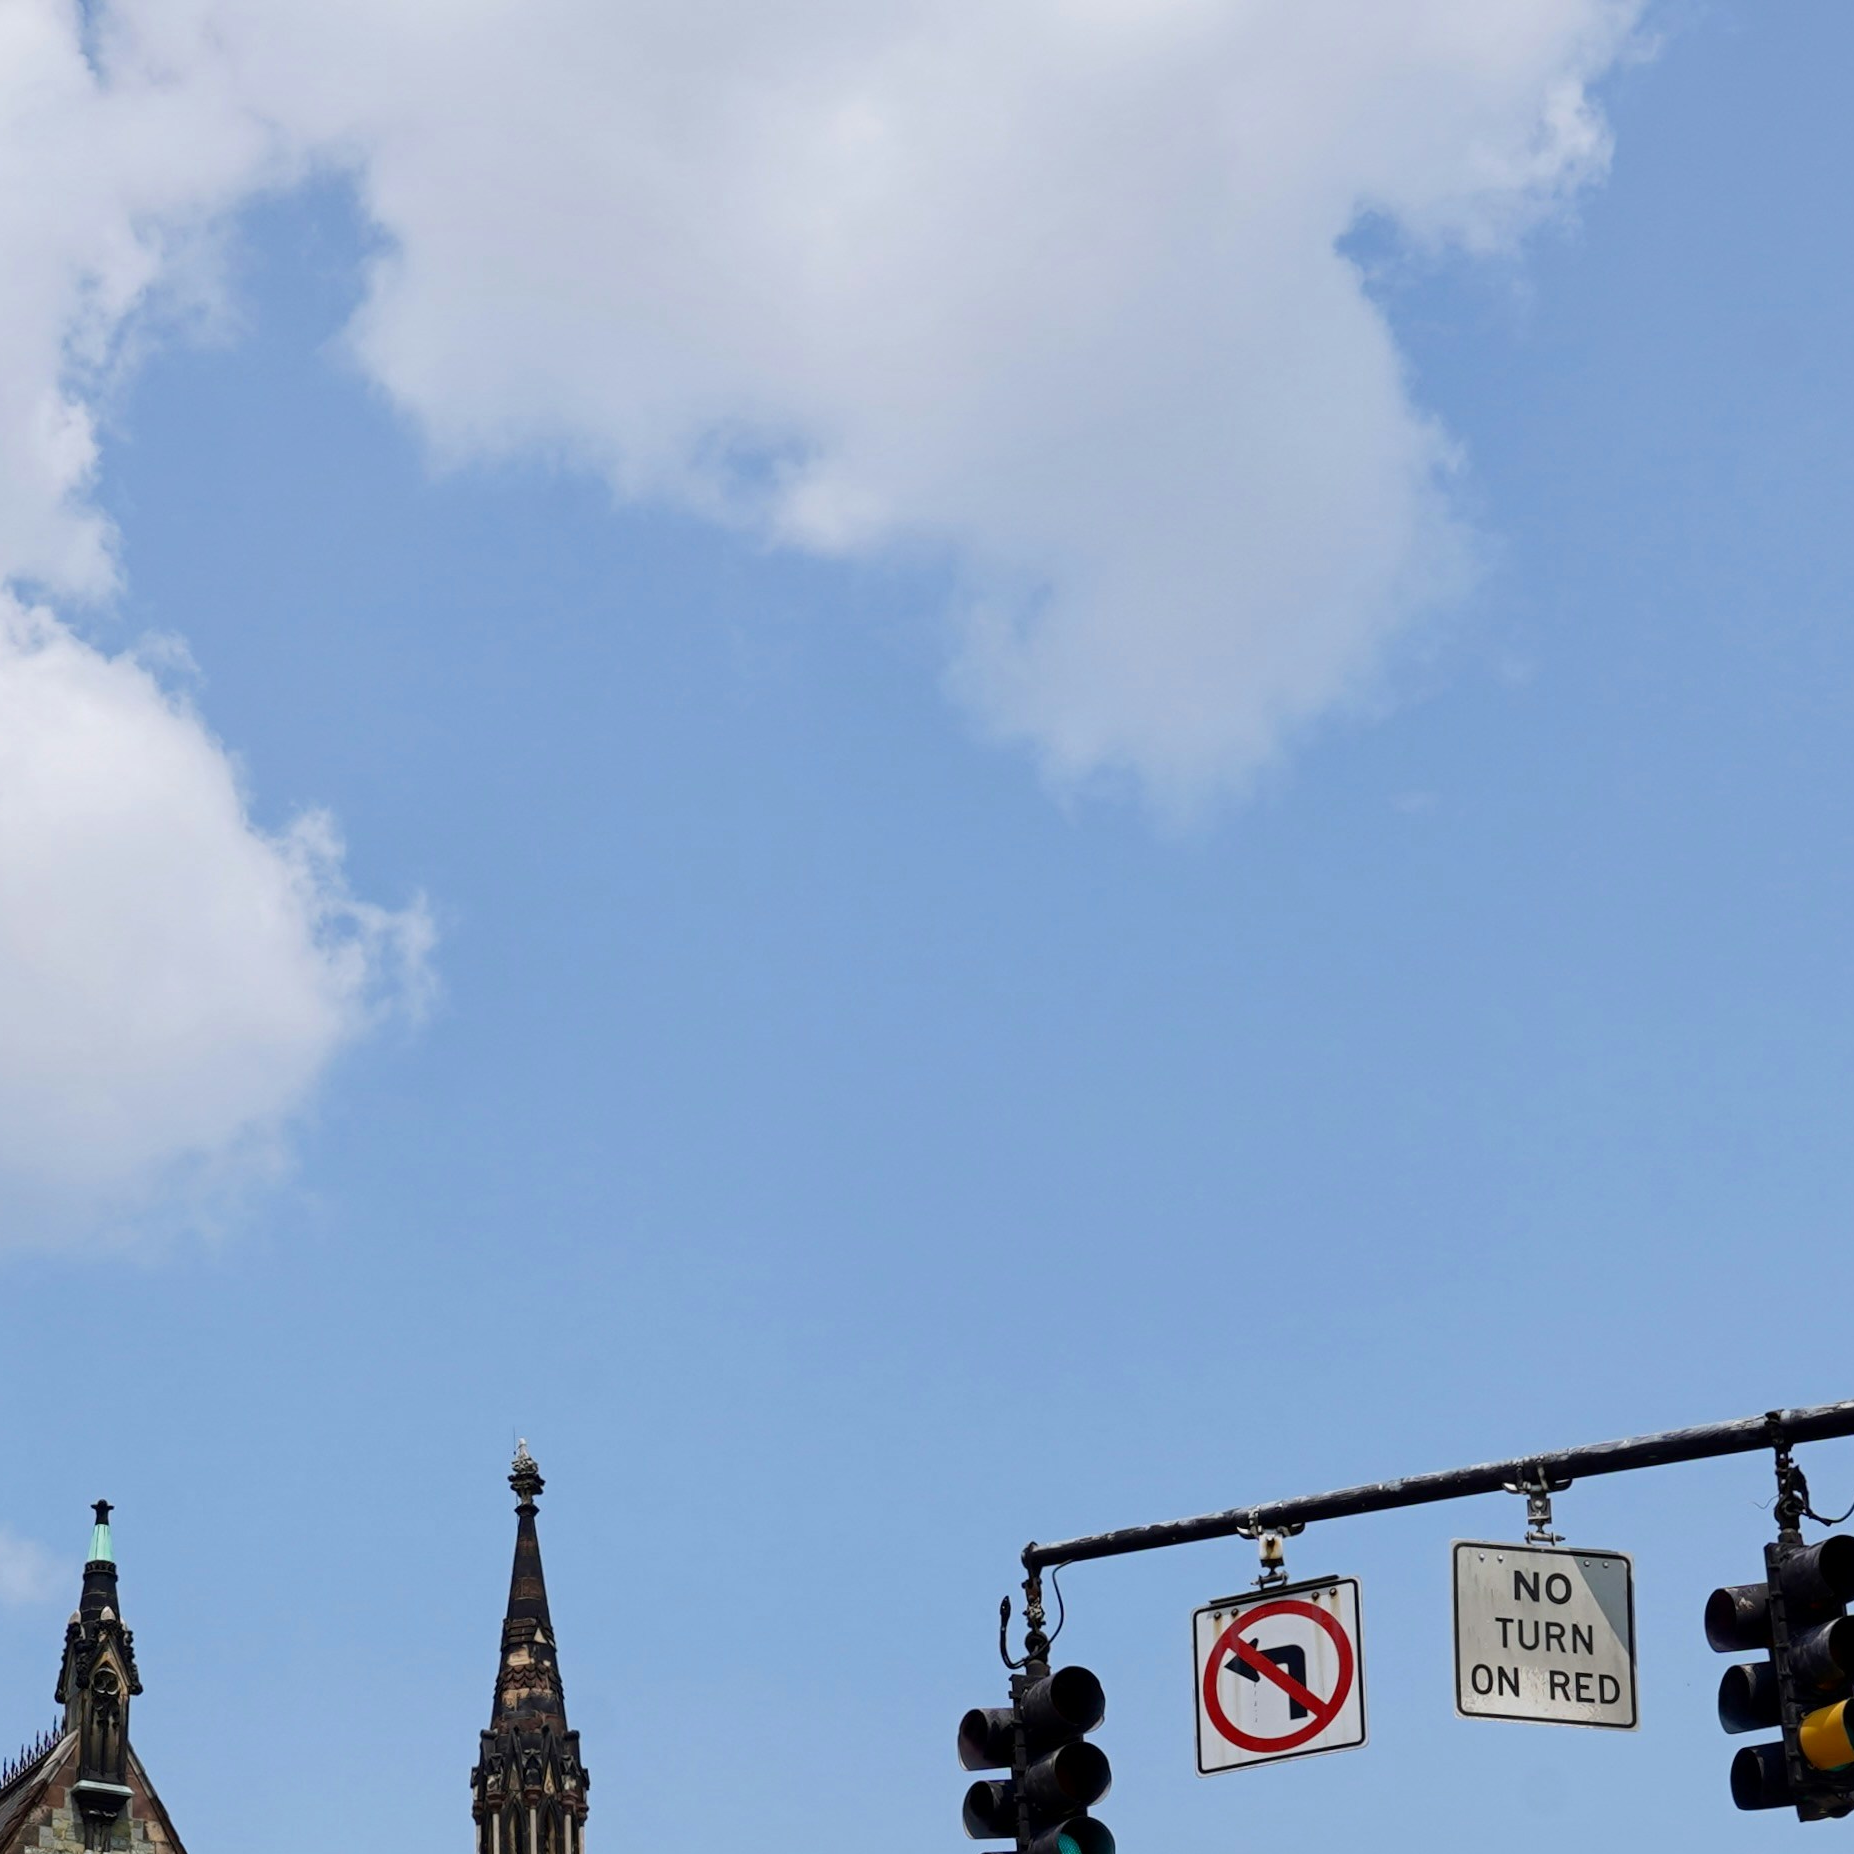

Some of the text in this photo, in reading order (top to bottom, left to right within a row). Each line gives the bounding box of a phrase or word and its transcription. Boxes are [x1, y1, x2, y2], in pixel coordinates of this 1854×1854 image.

[1514, 1570, 1572, 1605] NO
[1495, 1617, 1594, 1655] TURN
[1471, 1664, 1620, 1705] ON RED
